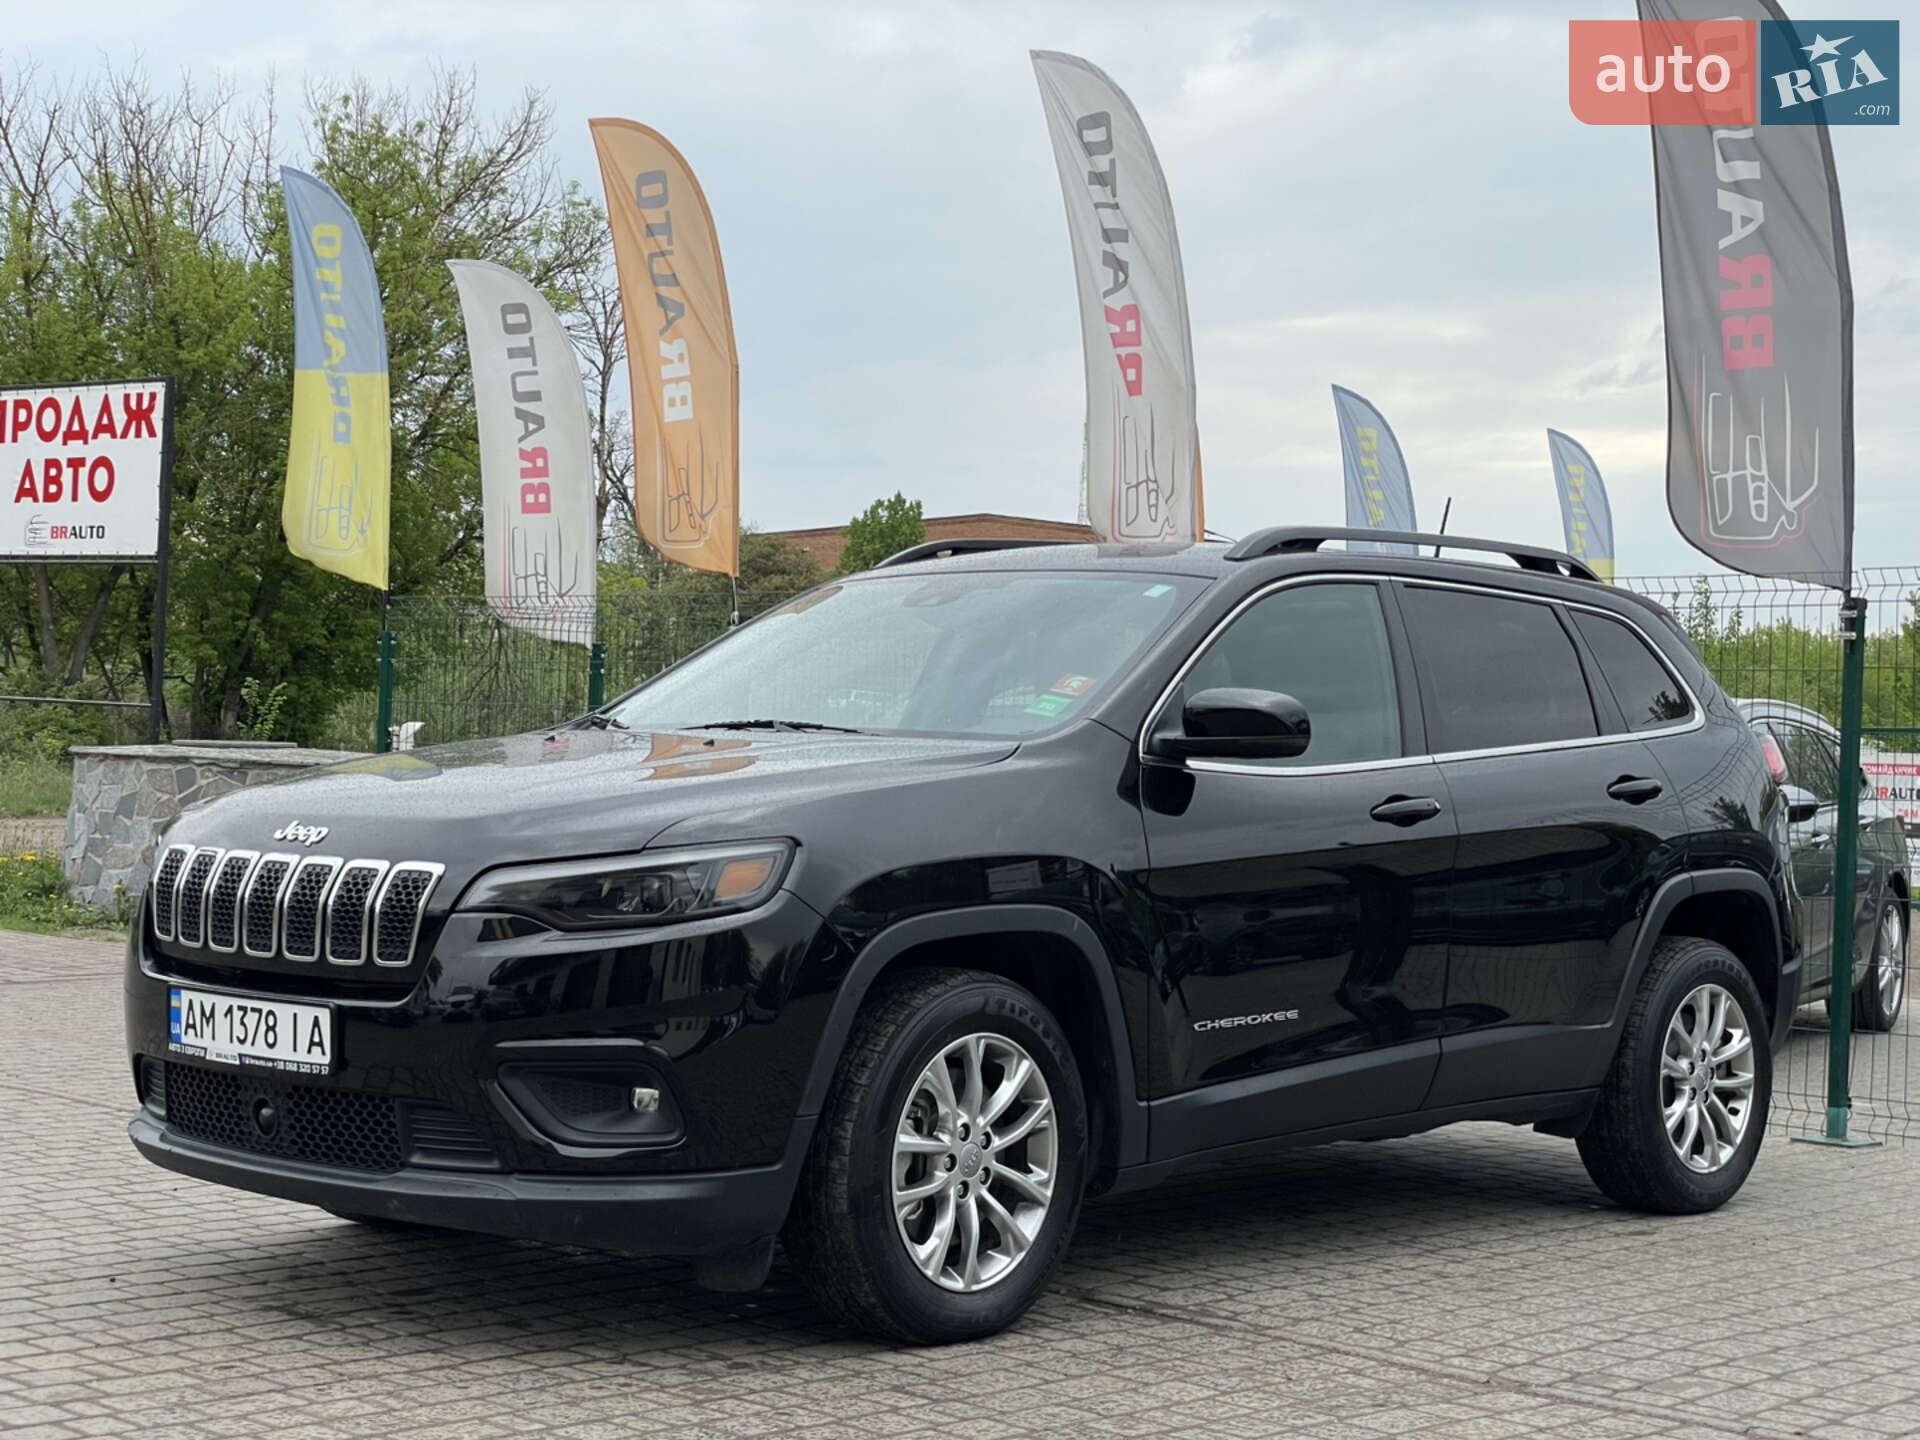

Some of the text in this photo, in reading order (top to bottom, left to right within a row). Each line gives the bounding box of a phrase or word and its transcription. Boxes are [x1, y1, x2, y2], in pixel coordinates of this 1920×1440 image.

[14, 455, 115, 503] АВТО
[51, 525, 105, 539] BRAUTO
[273, 820, 329, 847] Jeep
[184, 998, 327, 1056] AM 1378 IA
[1193, 1009, 1299, 1031] CHEROKEE
